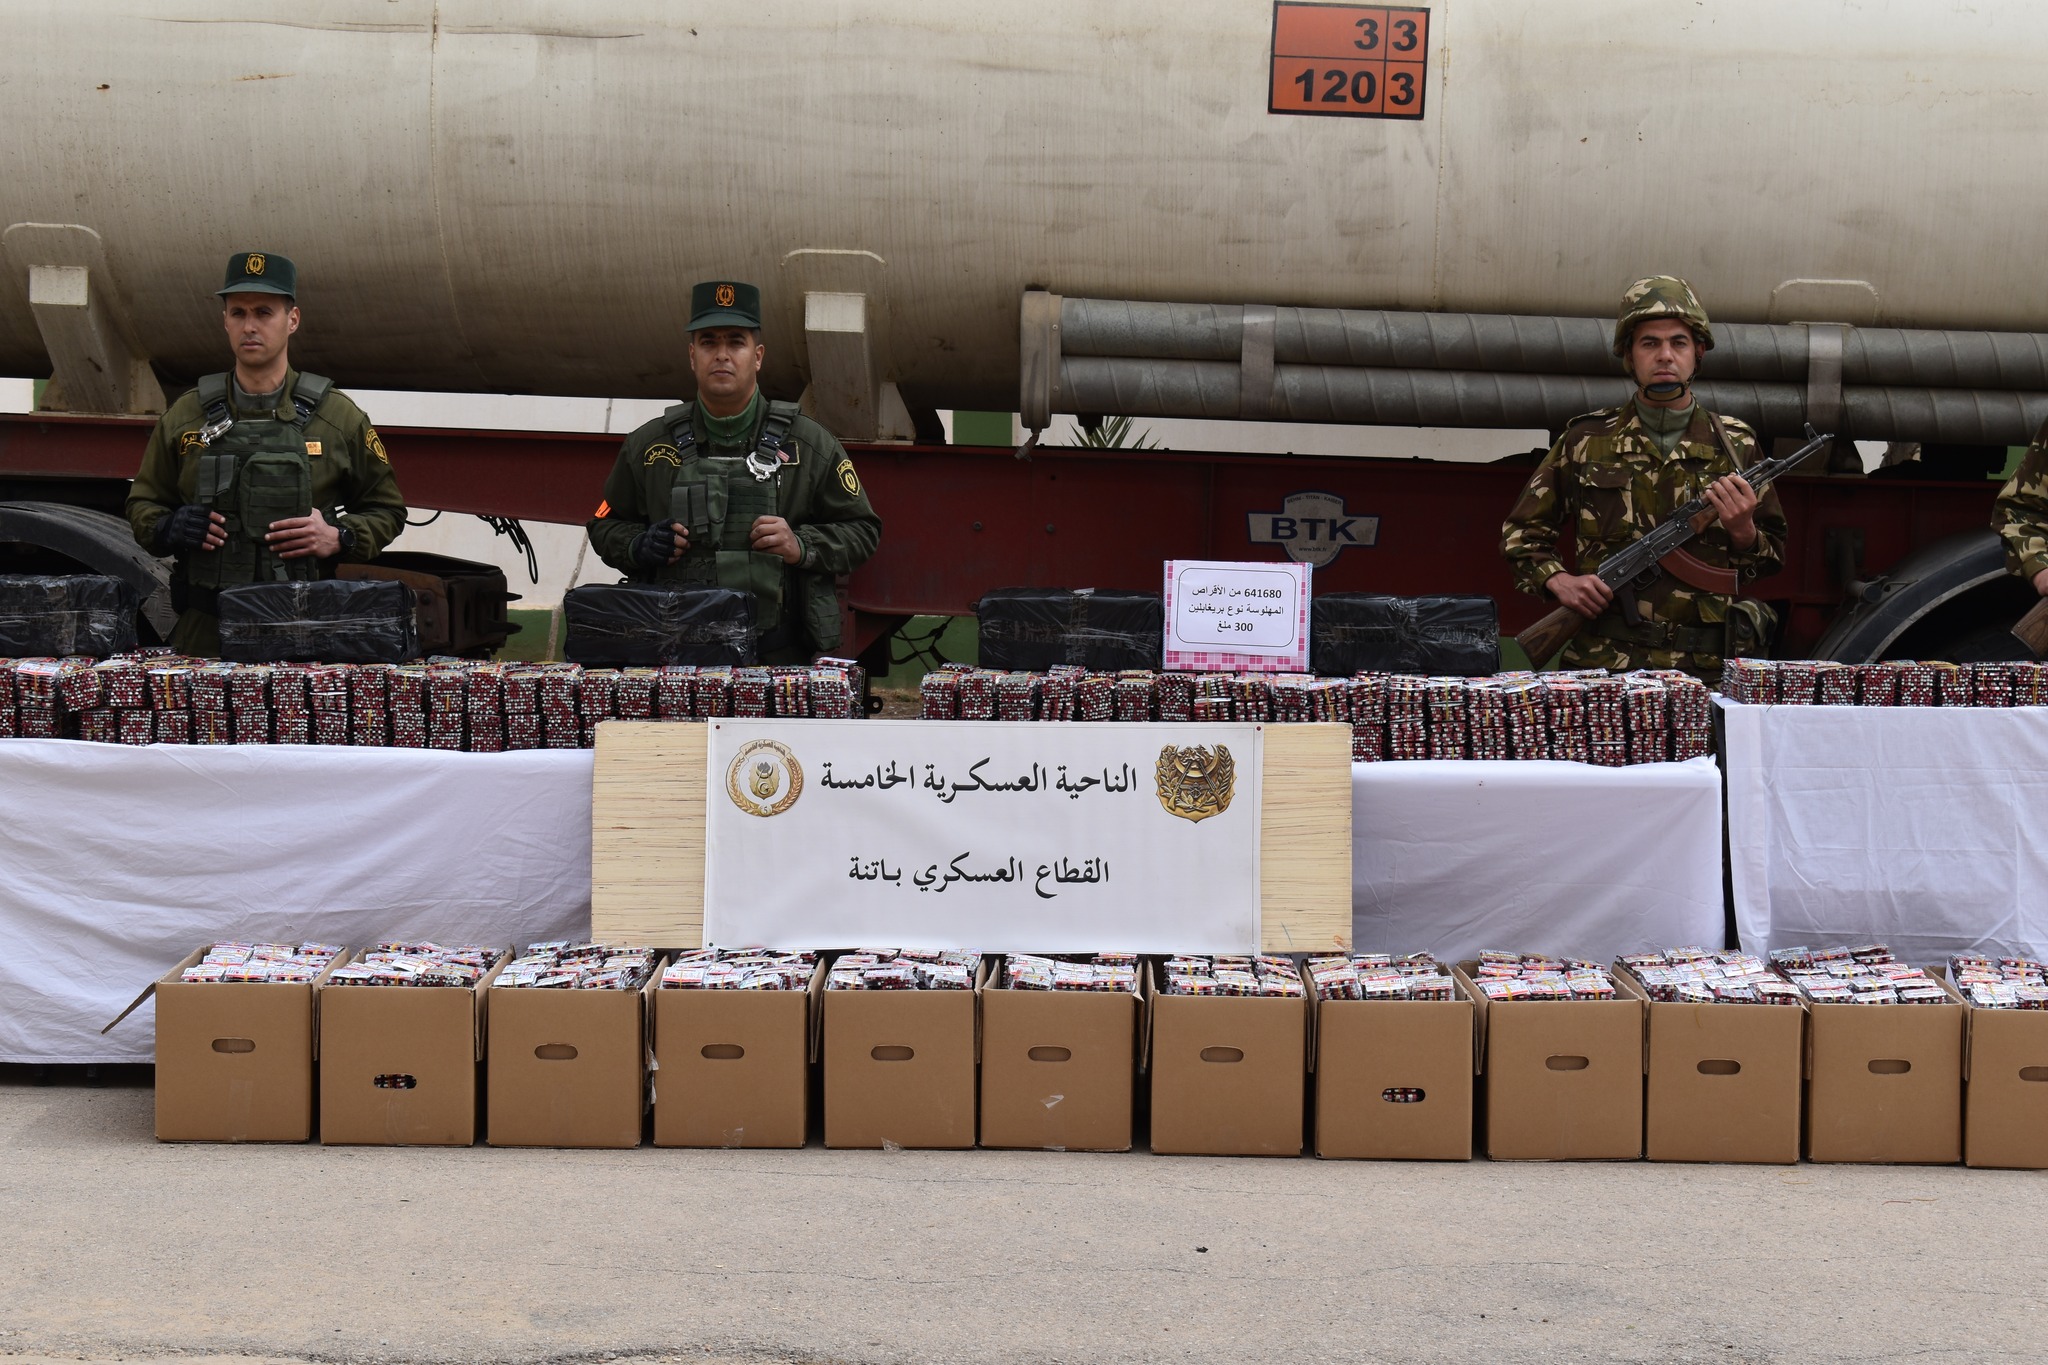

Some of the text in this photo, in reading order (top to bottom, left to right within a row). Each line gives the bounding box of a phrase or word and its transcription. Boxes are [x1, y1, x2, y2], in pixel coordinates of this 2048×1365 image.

[1271, 517, 1357, 542] BTK
[1192, 584, 1282, 599] 641680 من الأقراص
[1188, 603, 1284, 617] المهلوسة نوع بريغابلين
[1216, 620, 1253, 632] 300 ملغ
[820, 757, 1137, 804] الناحية العسكرية الخامسة
[848, 851, 1109, 899] القطاع العسكري باتنة
